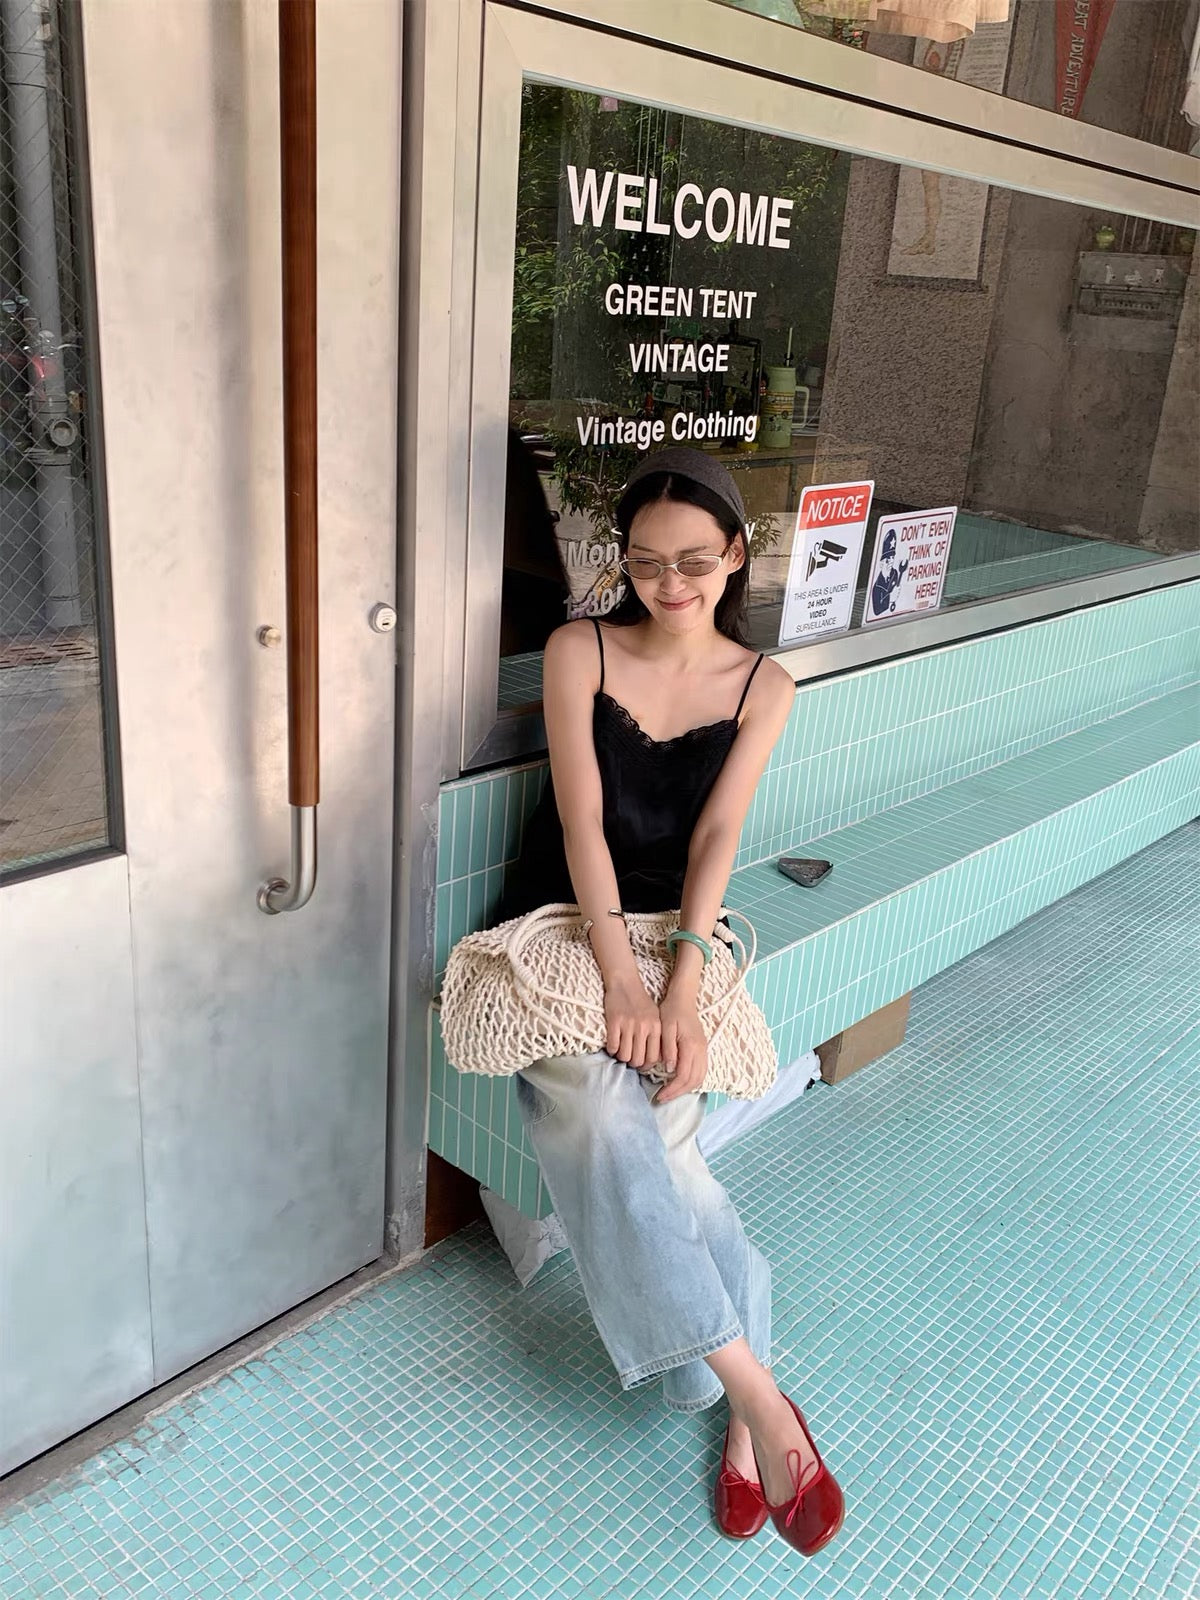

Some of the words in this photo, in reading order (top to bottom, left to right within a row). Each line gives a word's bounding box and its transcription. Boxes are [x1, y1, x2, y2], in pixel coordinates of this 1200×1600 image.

[1073, 0, 1091, 30] EAT
[1060, 31, 1085, 115] ADVENTURE
[567, 165, 794, 249] WELCOME
[605, 283, 693, 317] GREEN
[699, 289, 757, 319] TENT
[629, 343, 730, 373] VINTAGE
[577, 415, 665, 450] Vintage
[671, 410, 758, 443] Clothing
[806, 494, 865, 522] NOTICE
[901, 522, 927, 542] DON'T
[928, 520, 950, 537] EVEN
[908, 543, 932, 561] THINK
[934, 540, 946, 556] OF
[907, 561, 942, 582] PARKING
[794, 591, 807, 601] THIS
[807, 588, 822, 599] AREA
[823, 586, 829, 595] IS
[829, 583, 849, 595] UNDER
[914, 581, 938, 599] HERE!
[807, 600, 815, 609] 24
[815, 597, 833, 607] HOUR
[809, 608, 827, 619] VIDEO
[795, 616, 837, 633] SURVEILLANCE
